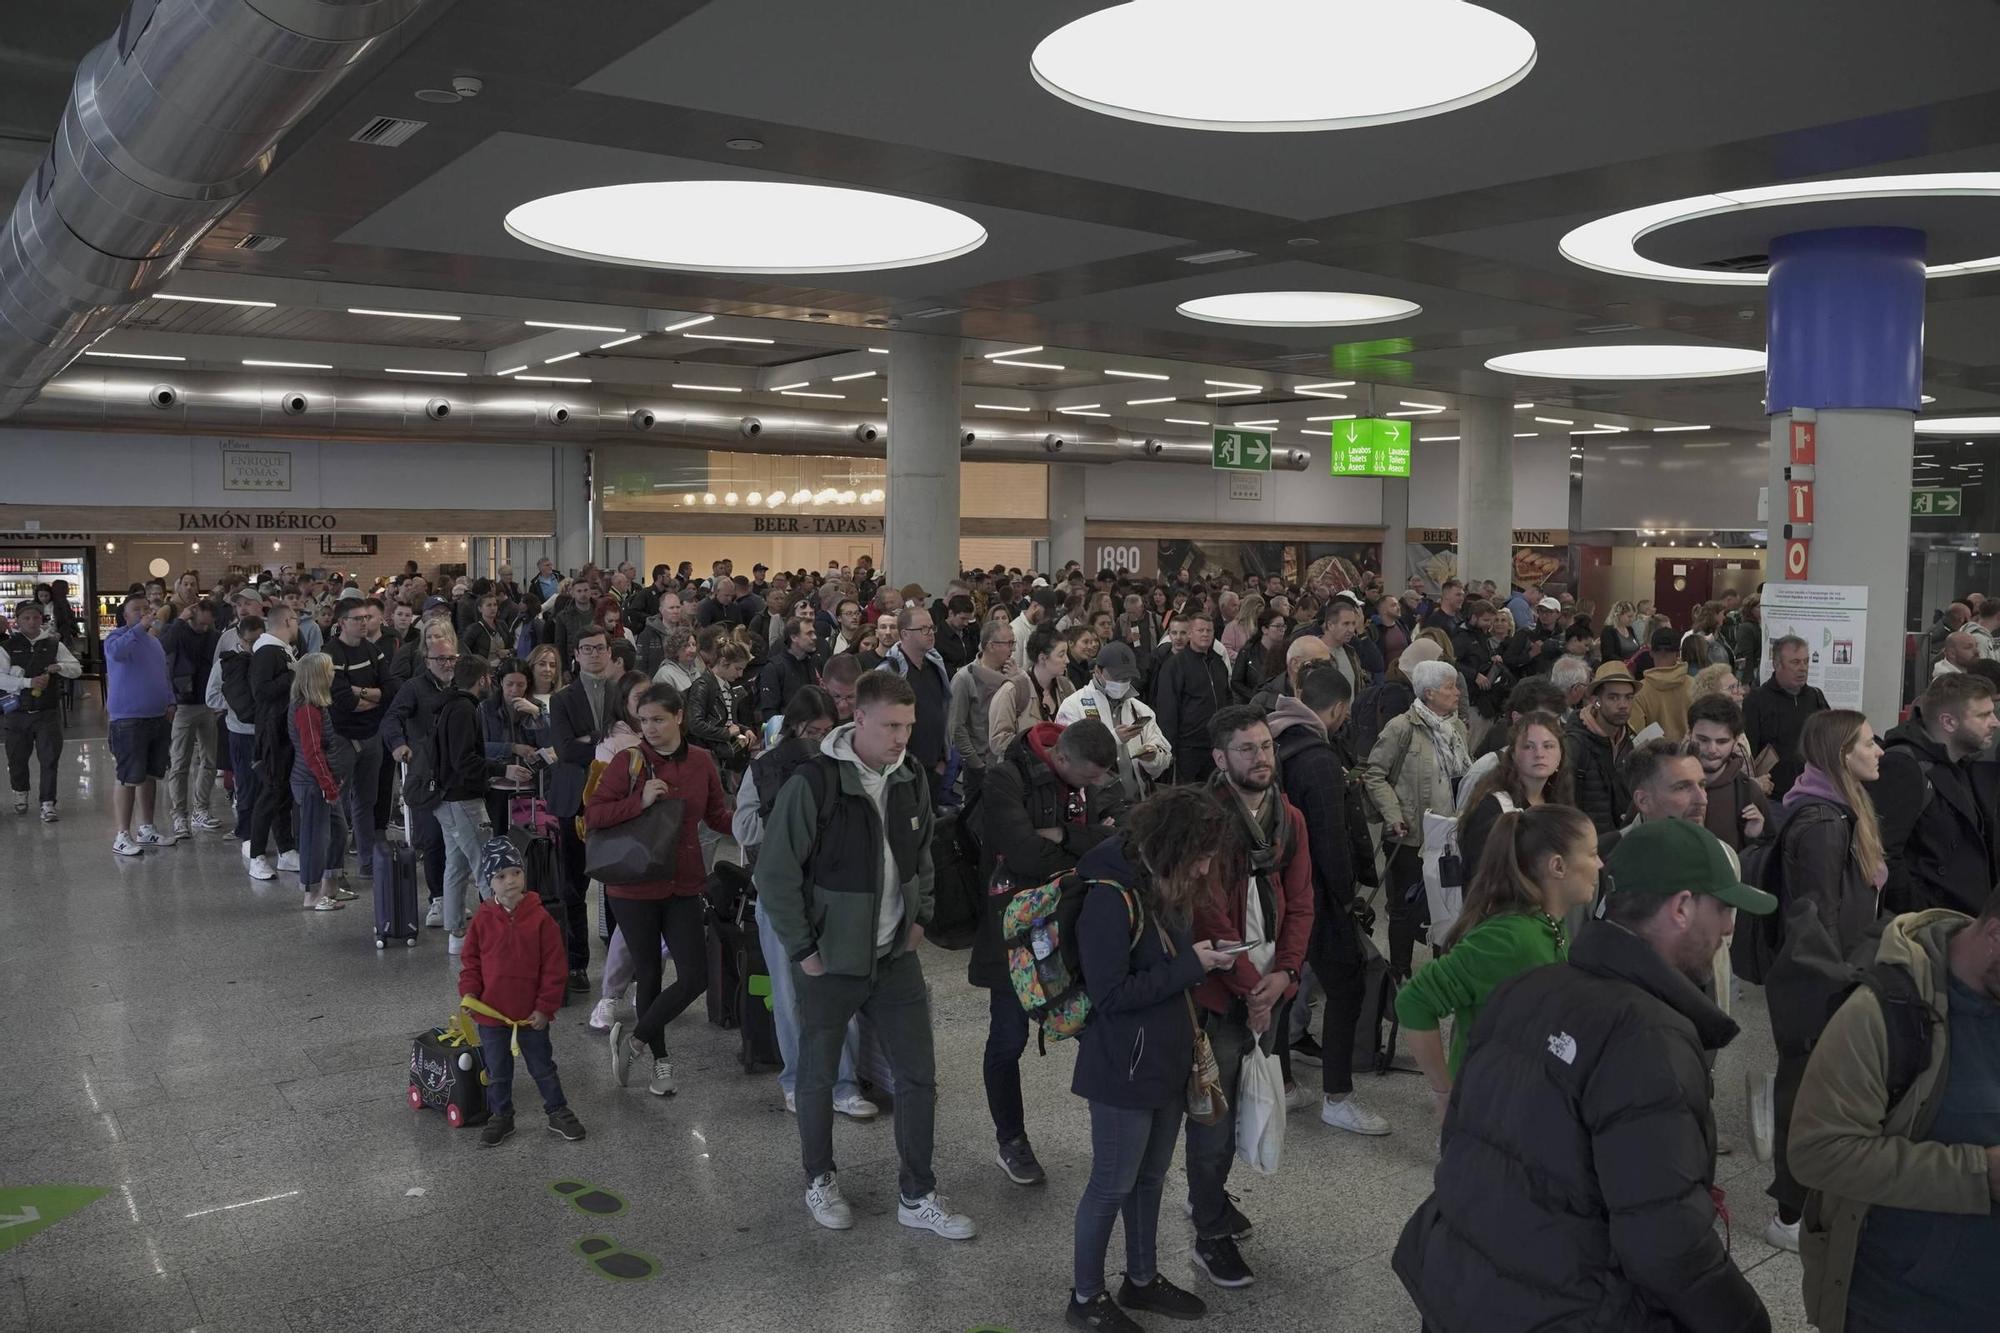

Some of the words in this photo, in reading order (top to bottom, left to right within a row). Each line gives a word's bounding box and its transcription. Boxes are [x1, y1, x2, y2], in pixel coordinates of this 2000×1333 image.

[1348, 446, 1371, 454] Lavabos
[1388, 447, 1410, 456] Lavabos
[231, 455, 285, 467] ENRIQUE
[1349, 454, 1367, 463] Toilets
[1389, 456, 1405, 465] Toilets
[1348, 463, 1366, 471] Aseos
[1388, 464, 1404, 473] Aseos
[178, 510, 250, 531] JAMÓN
[256, 511, 336, 529] IBÉRICO
[754, 517, 799, 532] BEER
[813, 518, 866, 533] TAPAS
[1423, 530, 1453, 542] BEER
[1513, 531, 1550, 544] WINE
[1096, 545, 1140, 573] 1890
[919, 1207, 941, 1225] N
